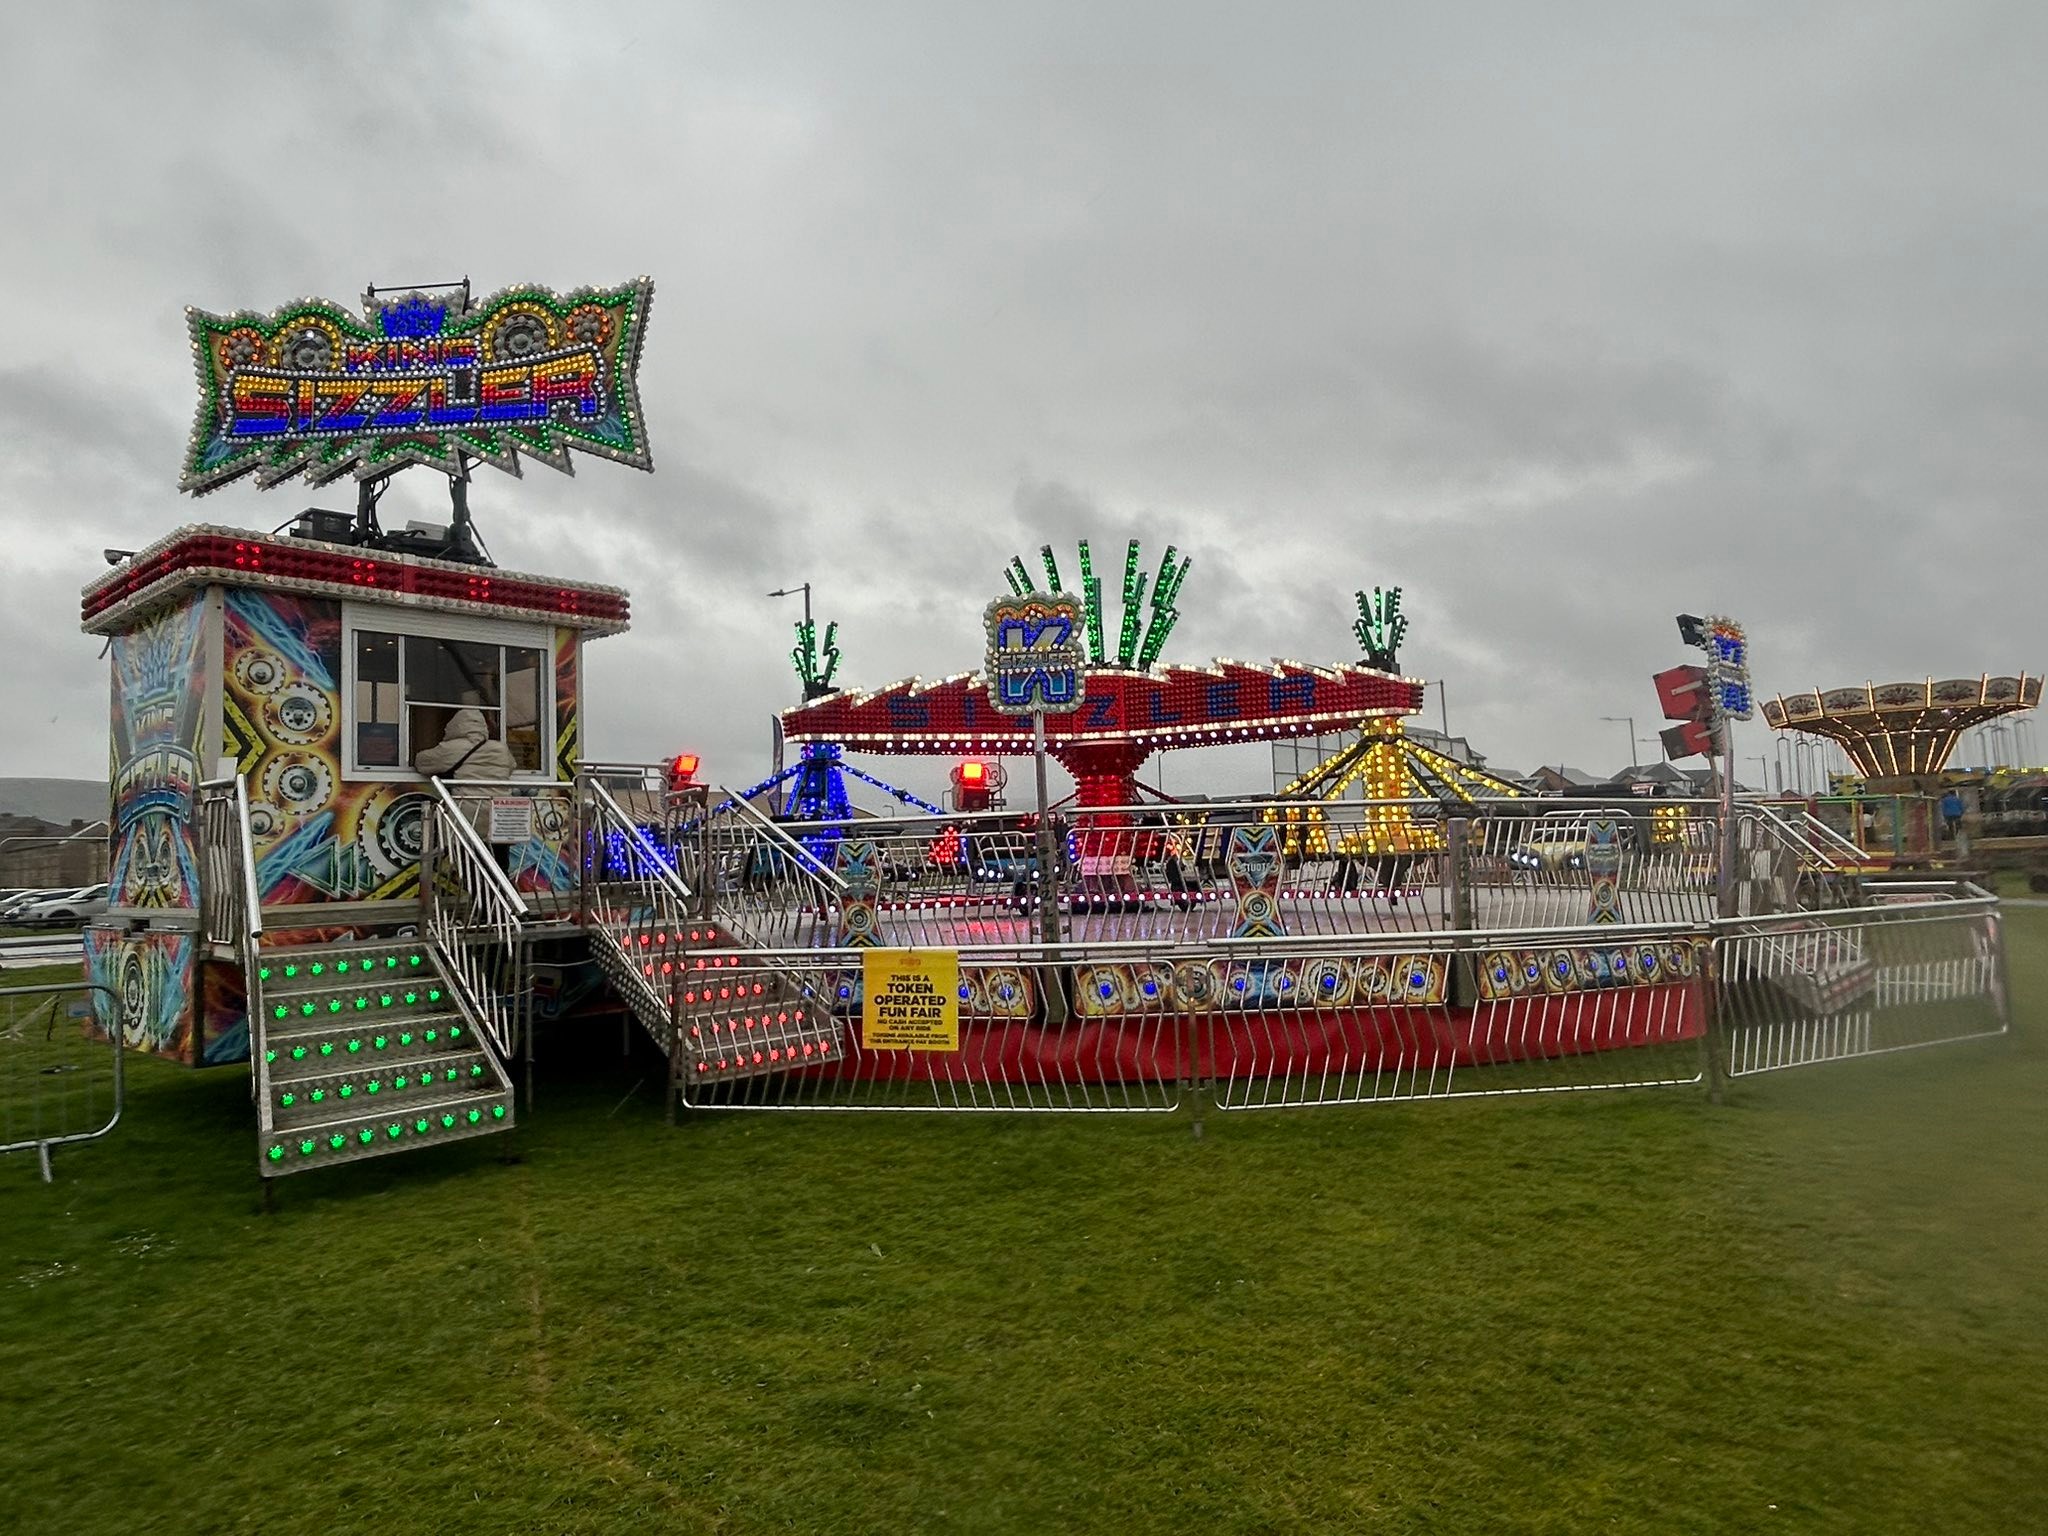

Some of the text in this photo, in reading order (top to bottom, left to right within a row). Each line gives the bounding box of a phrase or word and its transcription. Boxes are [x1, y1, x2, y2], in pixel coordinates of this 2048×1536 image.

[348, 340, 477, 371] KING
[231, 352, 597, 434] SIZZLER
[999, 653, 1071, 669] SIZZLER
[887, 983, 933, 993] TOKEN
[874, 995, 946, 1005] OPERATED
[880, 1007, 941, 1017] FUN FAIR
